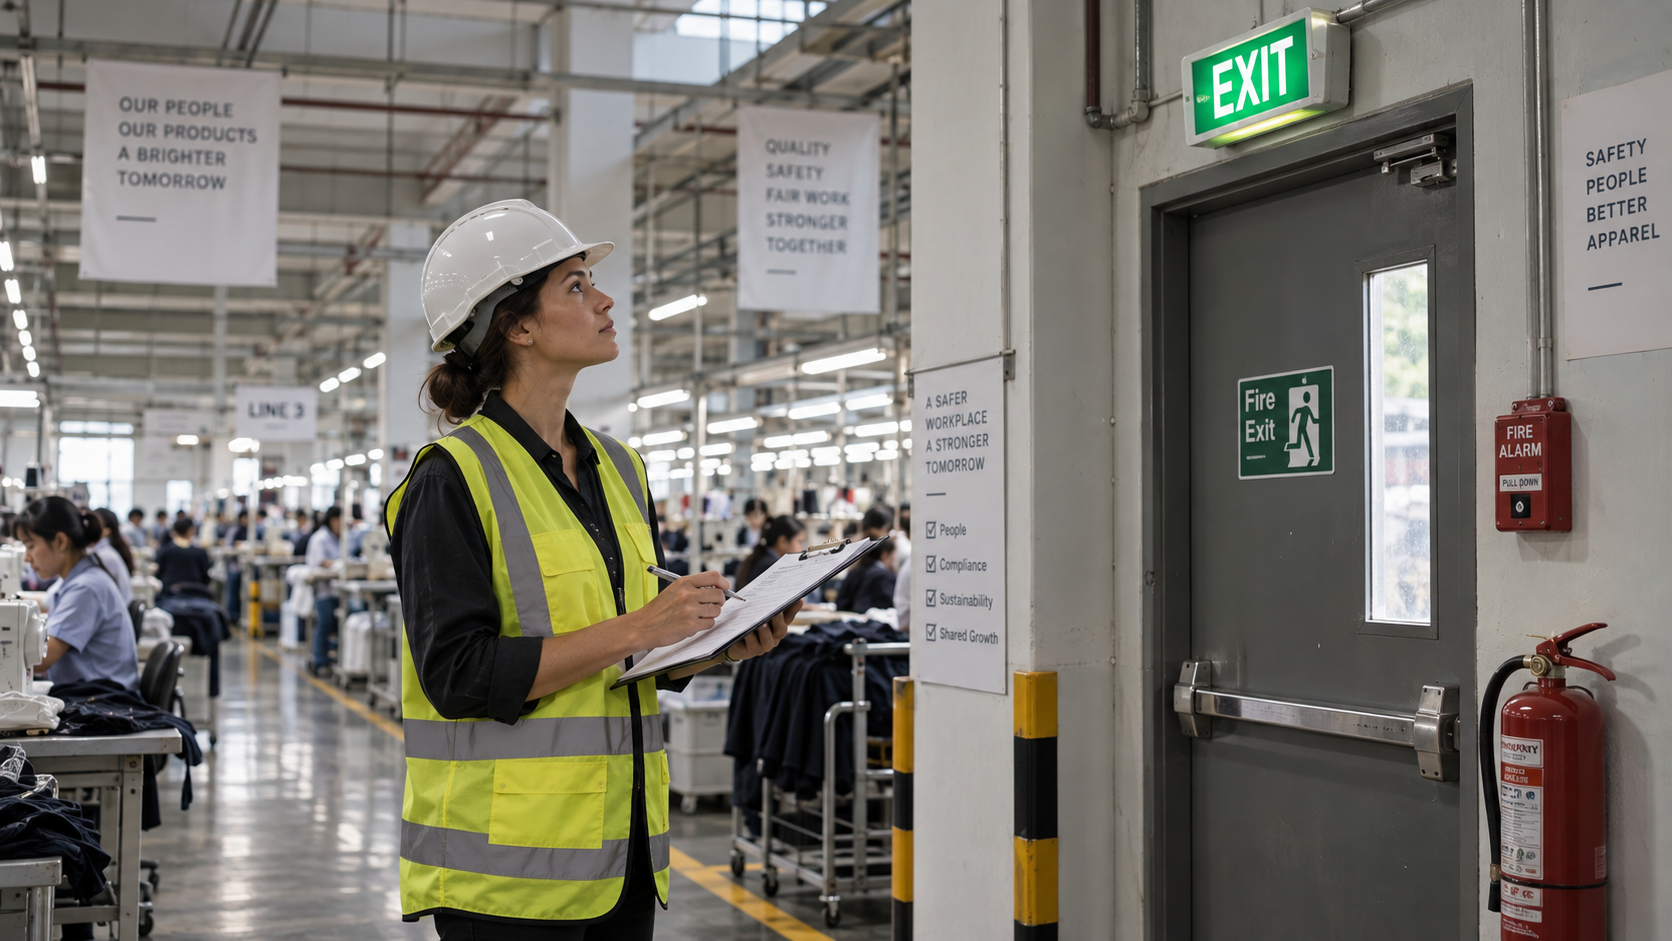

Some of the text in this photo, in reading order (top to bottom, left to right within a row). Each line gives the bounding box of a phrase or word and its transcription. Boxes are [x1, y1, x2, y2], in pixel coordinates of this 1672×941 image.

[1212, 35, 1294, 119] EXIT
[119, 96, 234, 118] OUR PEOPLE
[118, 121, 257, 144] OUR PRODUCTS
[117, 146, 226, 166] A BRIGHTER
[765, 138, 831, 157] QUALITY
[1586, 138, 1647, 167] SAFETY
[117, 169, 227, 190] TOMORROW
[765, 163, 824, 181] SAFETY
[1586, 167, 1647, 195] PEOPLE
[765, 187, 851, 206] FAIR WORK
[1587, 196, 1648, 223] BETTER
[765, 212, 849, 230] STRONGER
[766, 236, 847, 255] TOGETHER
[1586, 223, 1660, 251] APPAREL
[925, 390, 968, 410] A SAFER
[1245, 388, 1276, 412] Fire
[248, 401, 305, 420] LINE 3
[925, 410, 988, 431] WORKPLACE
[1245, 418, 1276, 443] Exit
[1507, 424, 1533, 440] FIRE
[925, 433, 989, 453] A STRONGER
[1499, 442, 1542, 458] ALARM
[925, 456, 985, 474] TOMORROW
[1502, 477, 1539, 487] PULL DOWN
[940, 523, 967, 539] People
[940, 558, 987, 574] Compliance
[940, 592, 993, 611] Sustainability
[940, 627, 999, 645] Shared Growth
